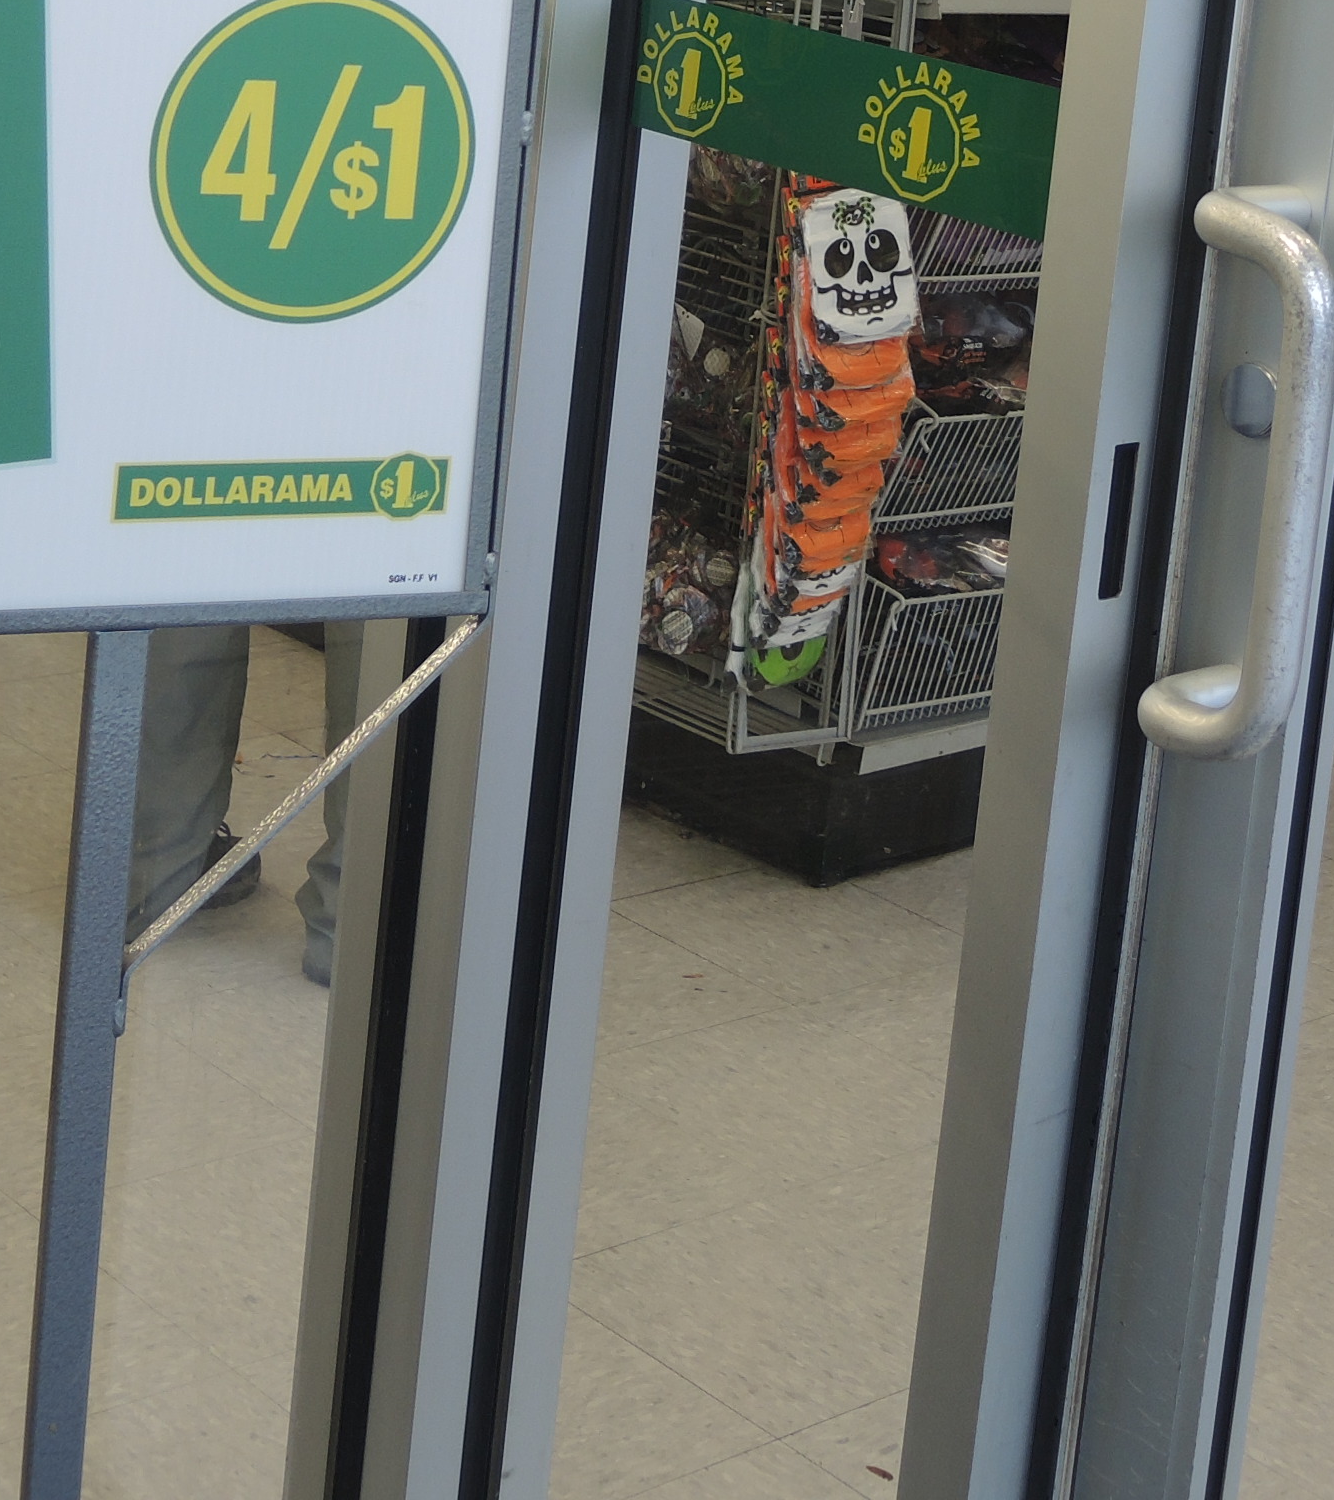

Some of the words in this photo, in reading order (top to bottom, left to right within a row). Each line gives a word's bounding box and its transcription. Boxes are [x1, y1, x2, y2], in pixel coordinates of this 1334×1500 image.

[637, 6, 745, 104] DOLLARAMA
[664, 48, 701, 119] $1
[200, 64, 427, 250] 4/$1
[858, 61, 981, 168] DOLLARAMA
[888, 106, 932, 183] $1
[130, 473, 353, 508] DOLLARAMA
